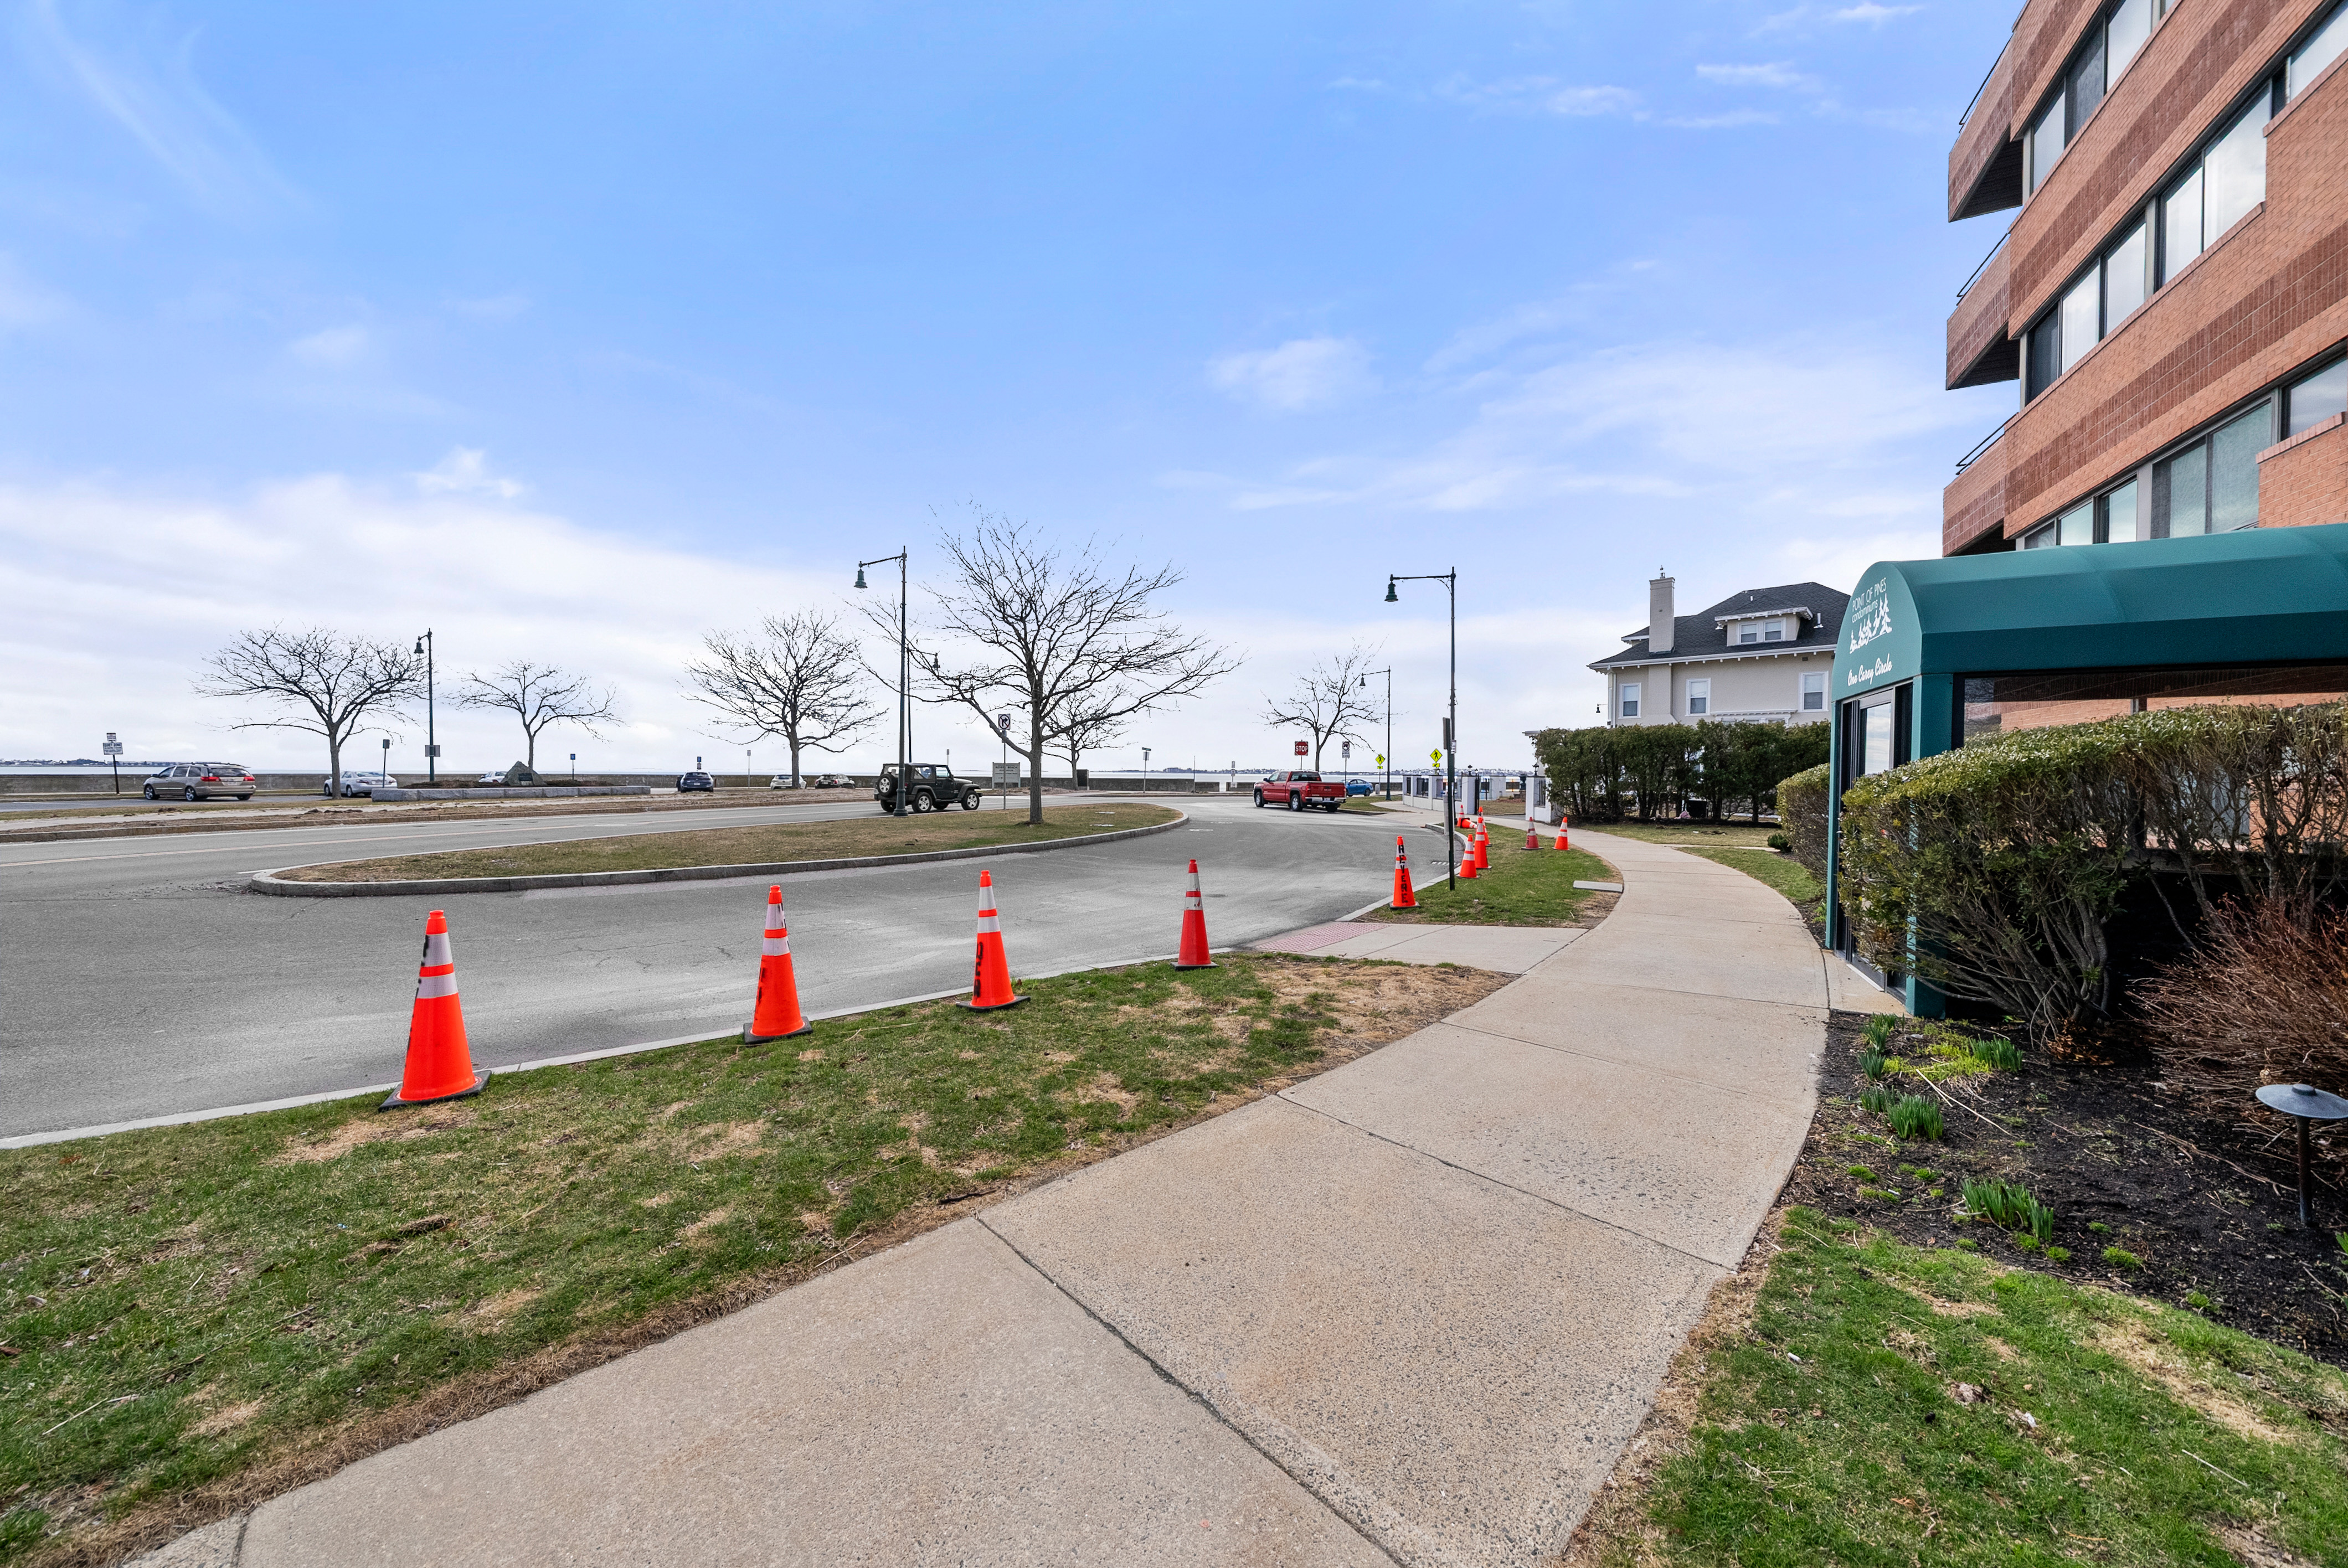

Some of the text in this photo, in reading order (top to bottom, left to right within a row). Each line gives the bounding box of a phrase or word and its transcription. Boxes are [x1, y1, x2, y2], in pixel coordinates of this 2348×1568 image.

[1852, 577, 1887, 612] POINT OF PINES
[1852, 599, 1878, 623] condominiums
[1847, 653, 1893, 687] One Carey Circle
[1398, 844, 1409, 904] REVERE
